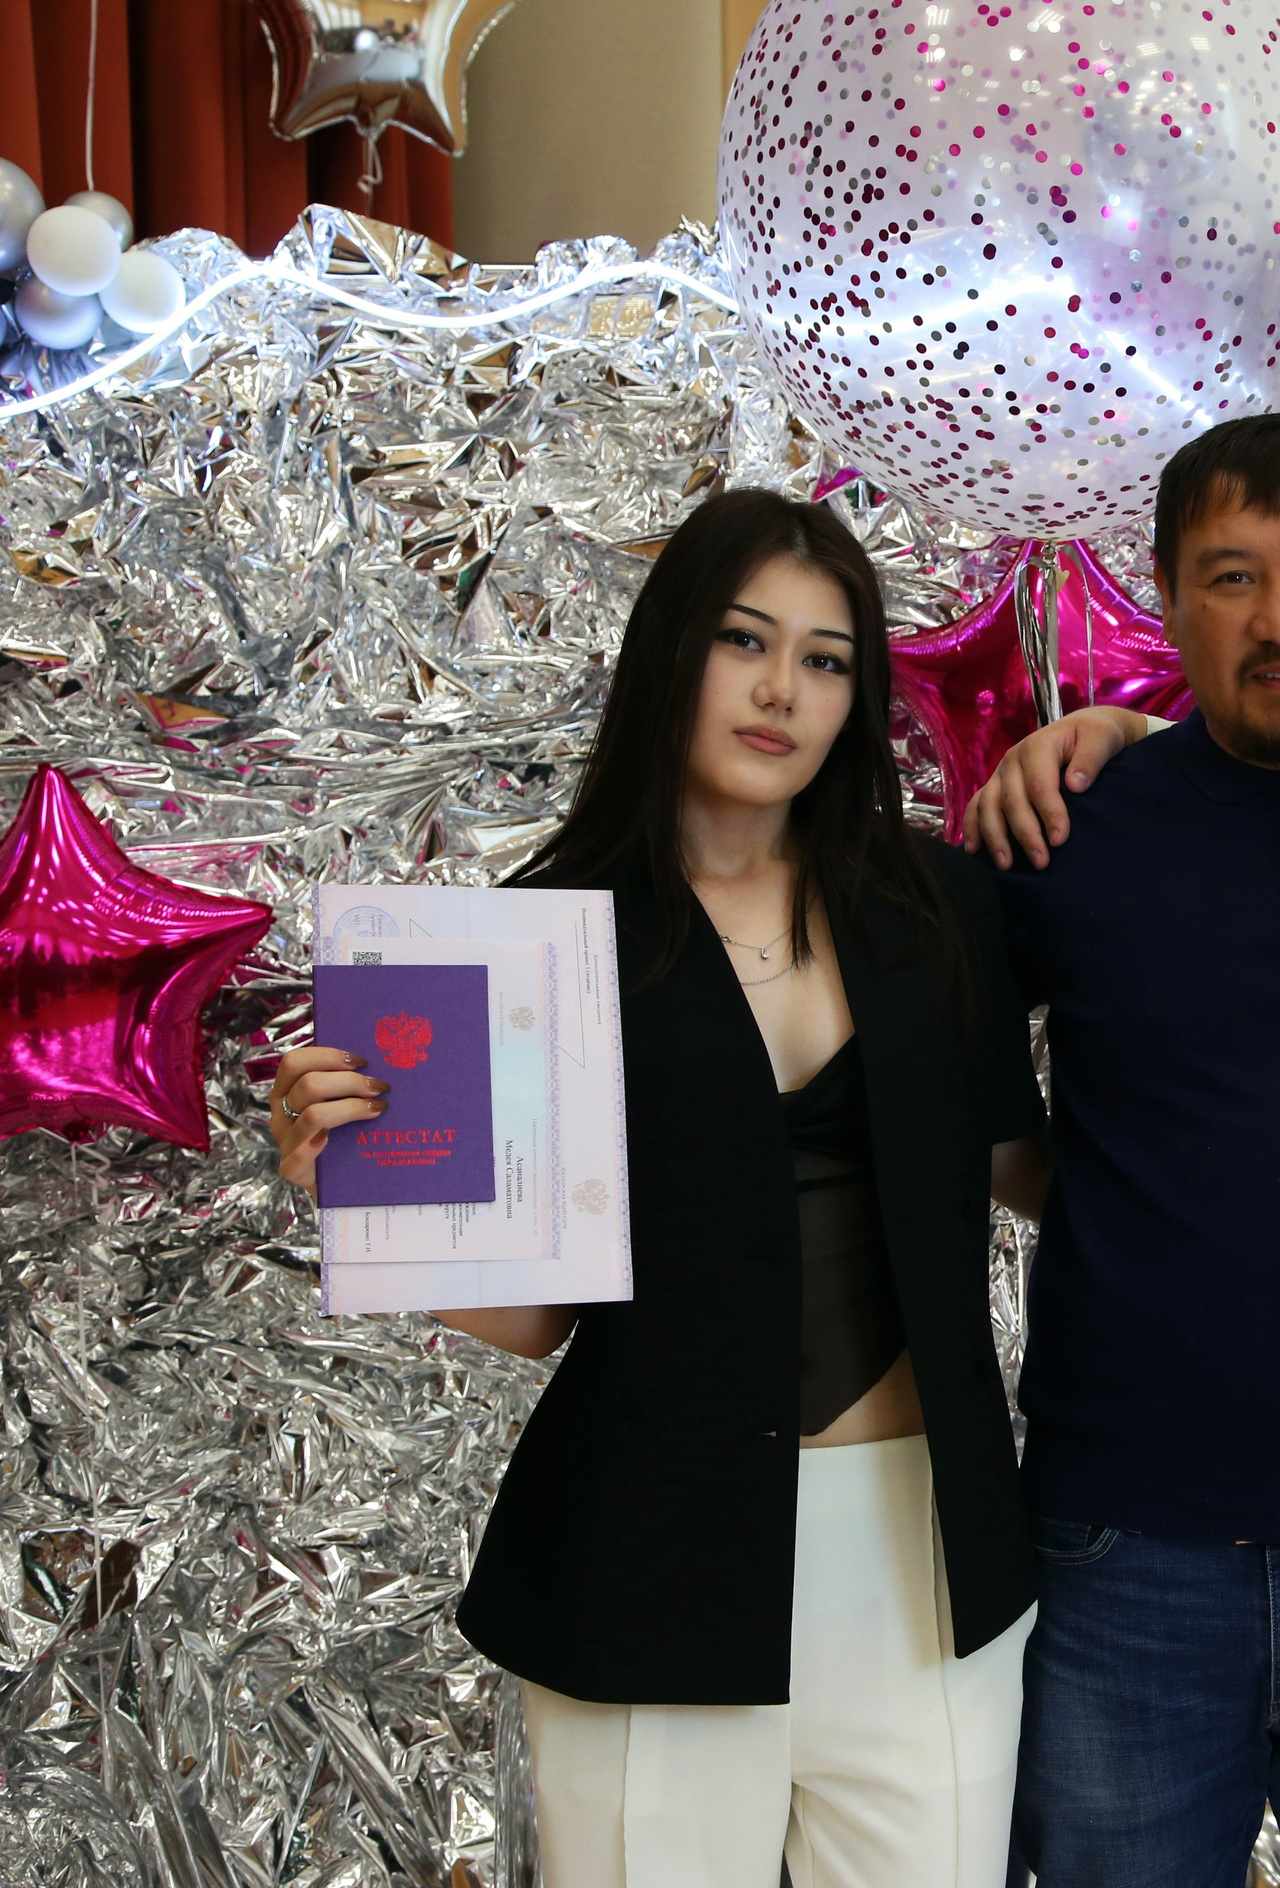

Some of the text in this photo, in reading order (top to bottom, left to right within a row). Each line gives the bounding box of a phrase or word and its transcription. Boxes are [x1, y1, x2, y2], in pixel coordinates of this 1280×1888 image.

[356, 1129, 457, 1145] АТТЕСТАТ
[505, 1140, 514, 1219] Медея Саламатовна
[516, 1156, 524, 1203] Асаналиева
